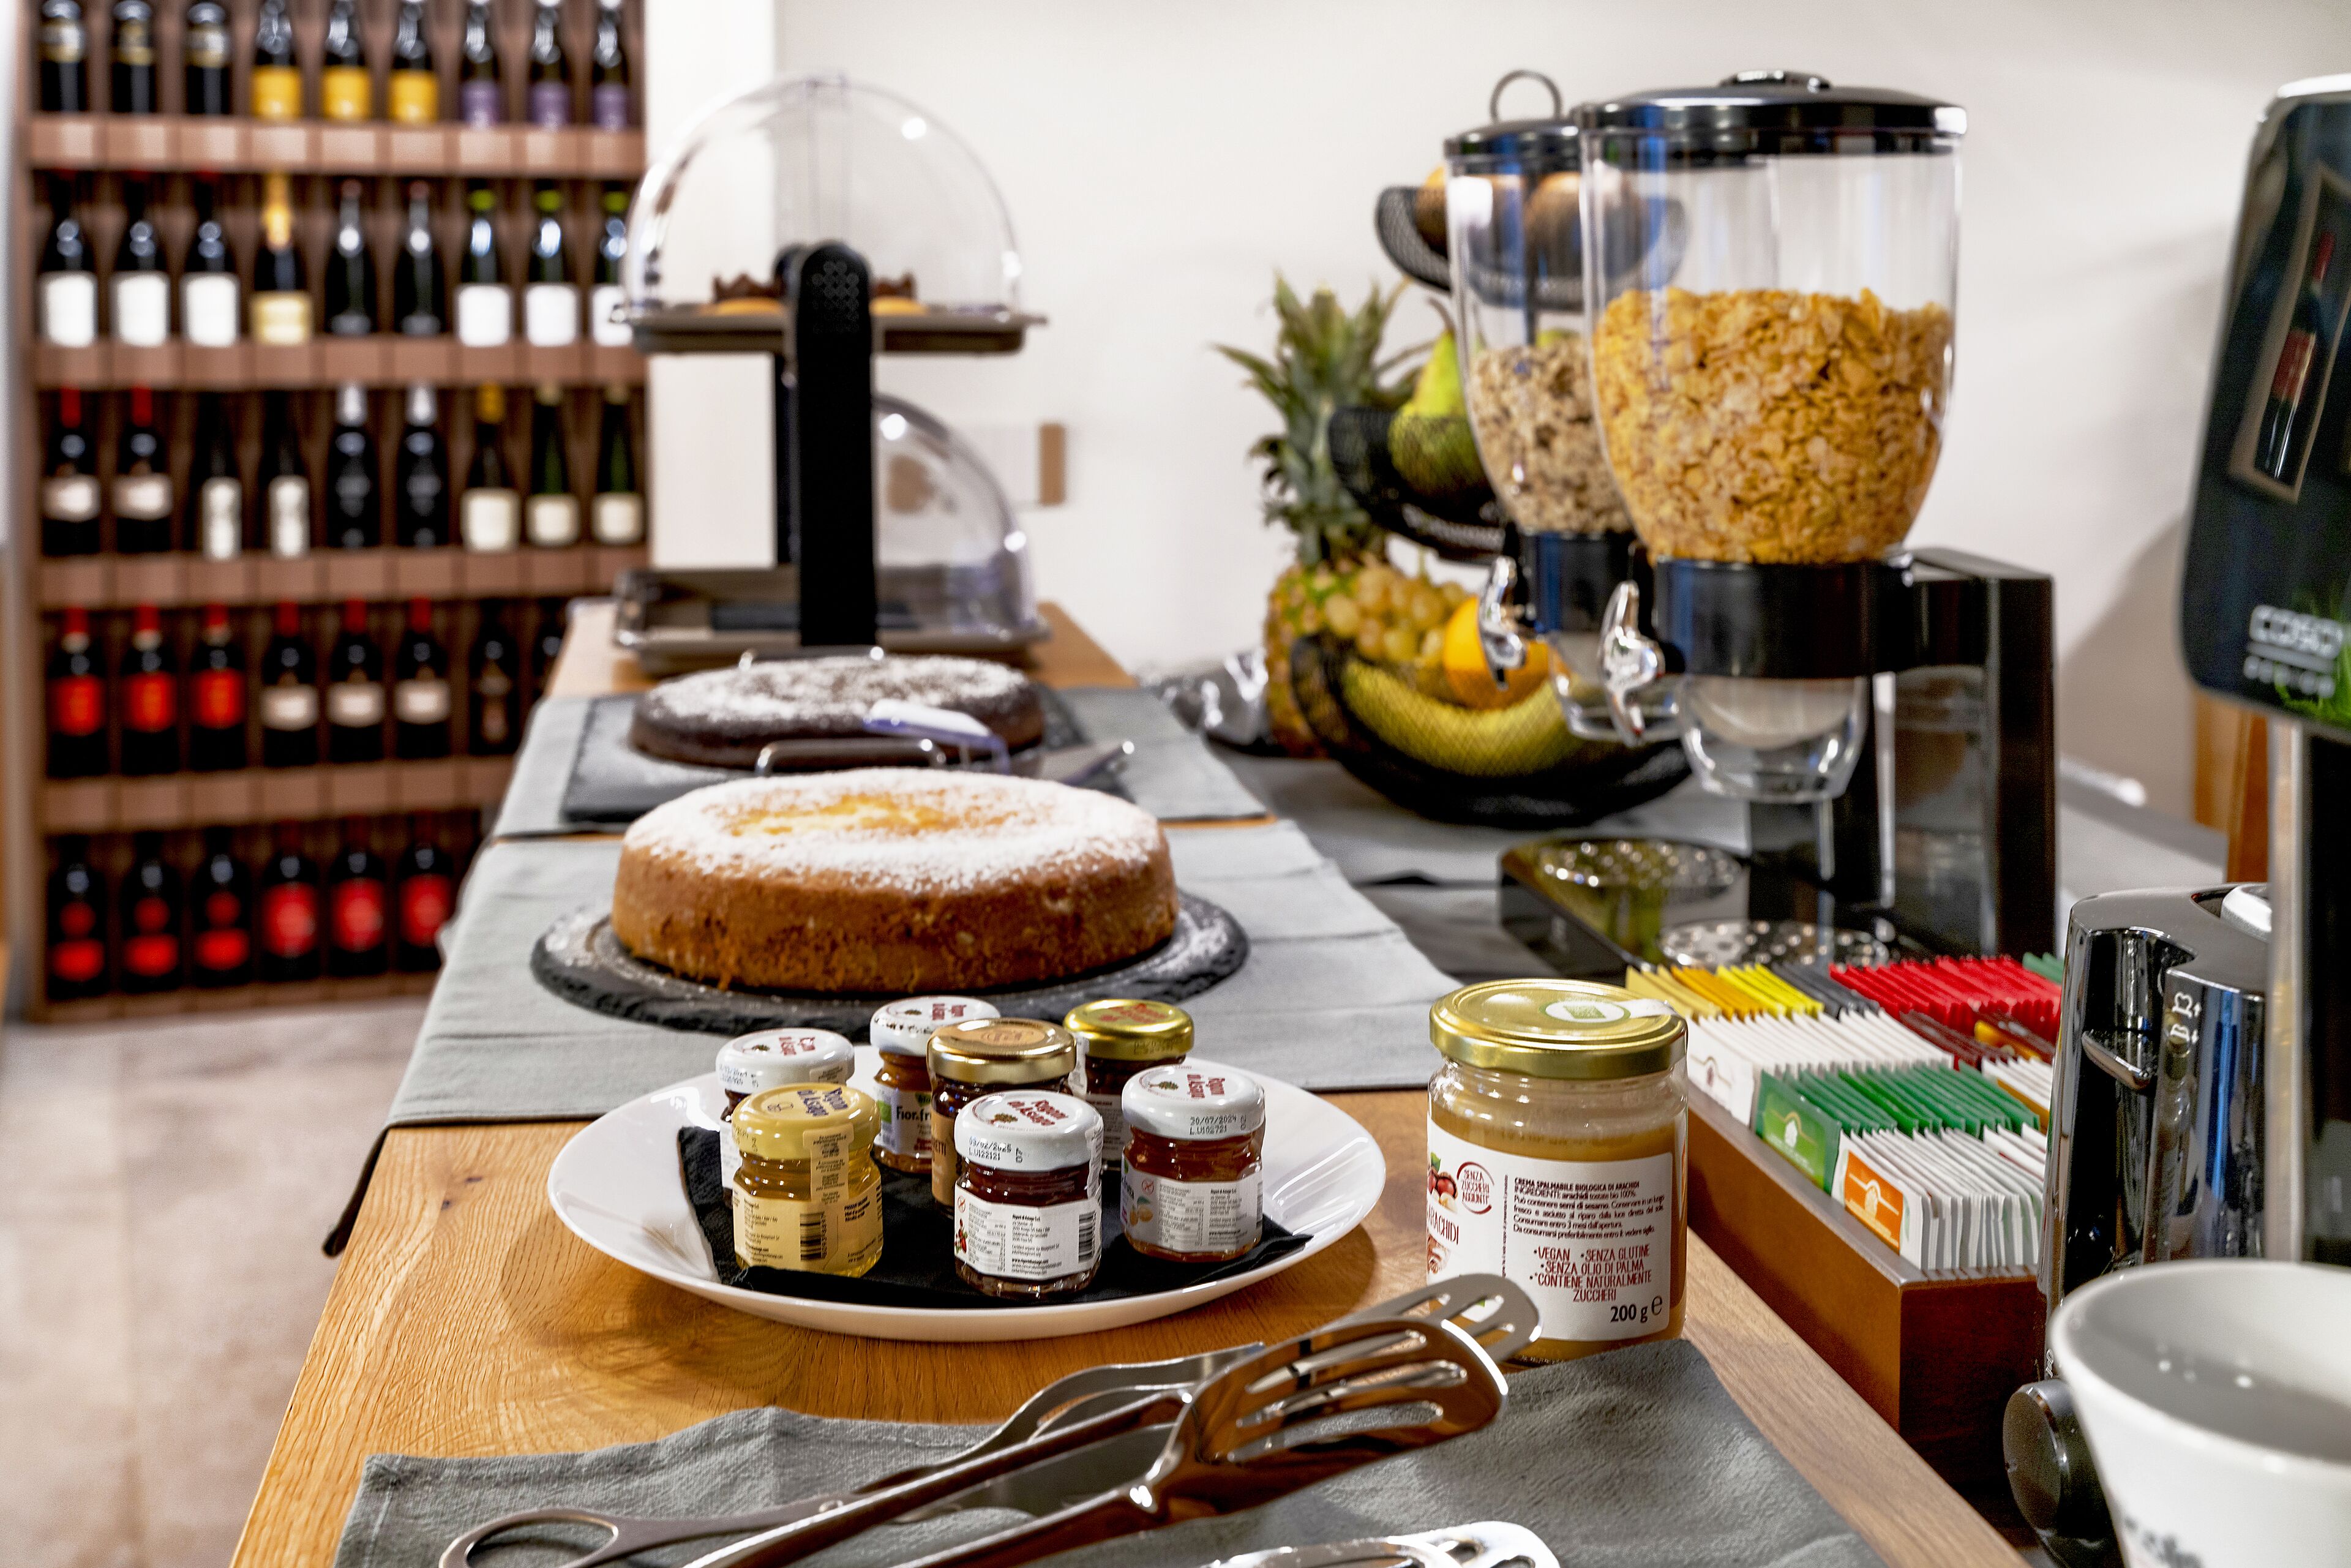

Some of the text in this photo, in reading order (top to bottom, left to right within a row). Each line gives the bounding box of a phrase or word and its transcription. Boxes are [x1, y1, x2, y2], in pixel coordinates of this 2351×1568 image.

[1515, 1177, 1640, 1192] CREMA SPALMABILE BIOLOGICA DI ARACHIDI
[1514, 1186, 1561, 1199] INGREDIENTI:
[1562, 1190, 1588, 1200] arachidi
[1589, 1191, 1609, 1200] tostate
[1513, 1195, 1526, 1205] Può
[1527, 1198, 1558, 1209] contenere
[1559, 1201, 1575, 1210] semi
[1577, 1202, 1583, 1210] di
[1611, 1198, 1641, 1209] Conservare
[1513, 1204, 1532, 1215] fresco
[1542, 1209, 1566, 1218] asciutto
[1569, 1210, 1575, 1220] al
[1578, 1210, 1596, 1221] riparo
[1599, 1209, 1611, 1220] dalla
[1614, 1209, 1625, 1218] luce
[1627, 1207, 1644, 1218] diretta
[1513, 1214, 1549, 1226] Consumare
[1550, 1218, 1566, 1229] entro
[1572, 1220, 1586, 1229] mesi
[1513, 1224, 1523, 1233] Da
[1523, 1226, 1556, 1238] consumarsi
[1558, 1229, 1603, 1240] preferibilmente
[1603, 1229, 1619, 1239] entro
[1625, 1226, 1642, 1237] vedere
[1538, 1244, 1650, 1262] VEGAN SENZA GLUTINE
[1545, 1259, 1644, 1275] SENZA OLIO DI PALMA
[1586, 1269, 1652, 1288] NATURALMENTE
[1573, 1288, 1617, 1302] ZUCCHERI
[1610, 1304, 1637, 1322] 200
[1640, 1306, 1648, 1323] g
